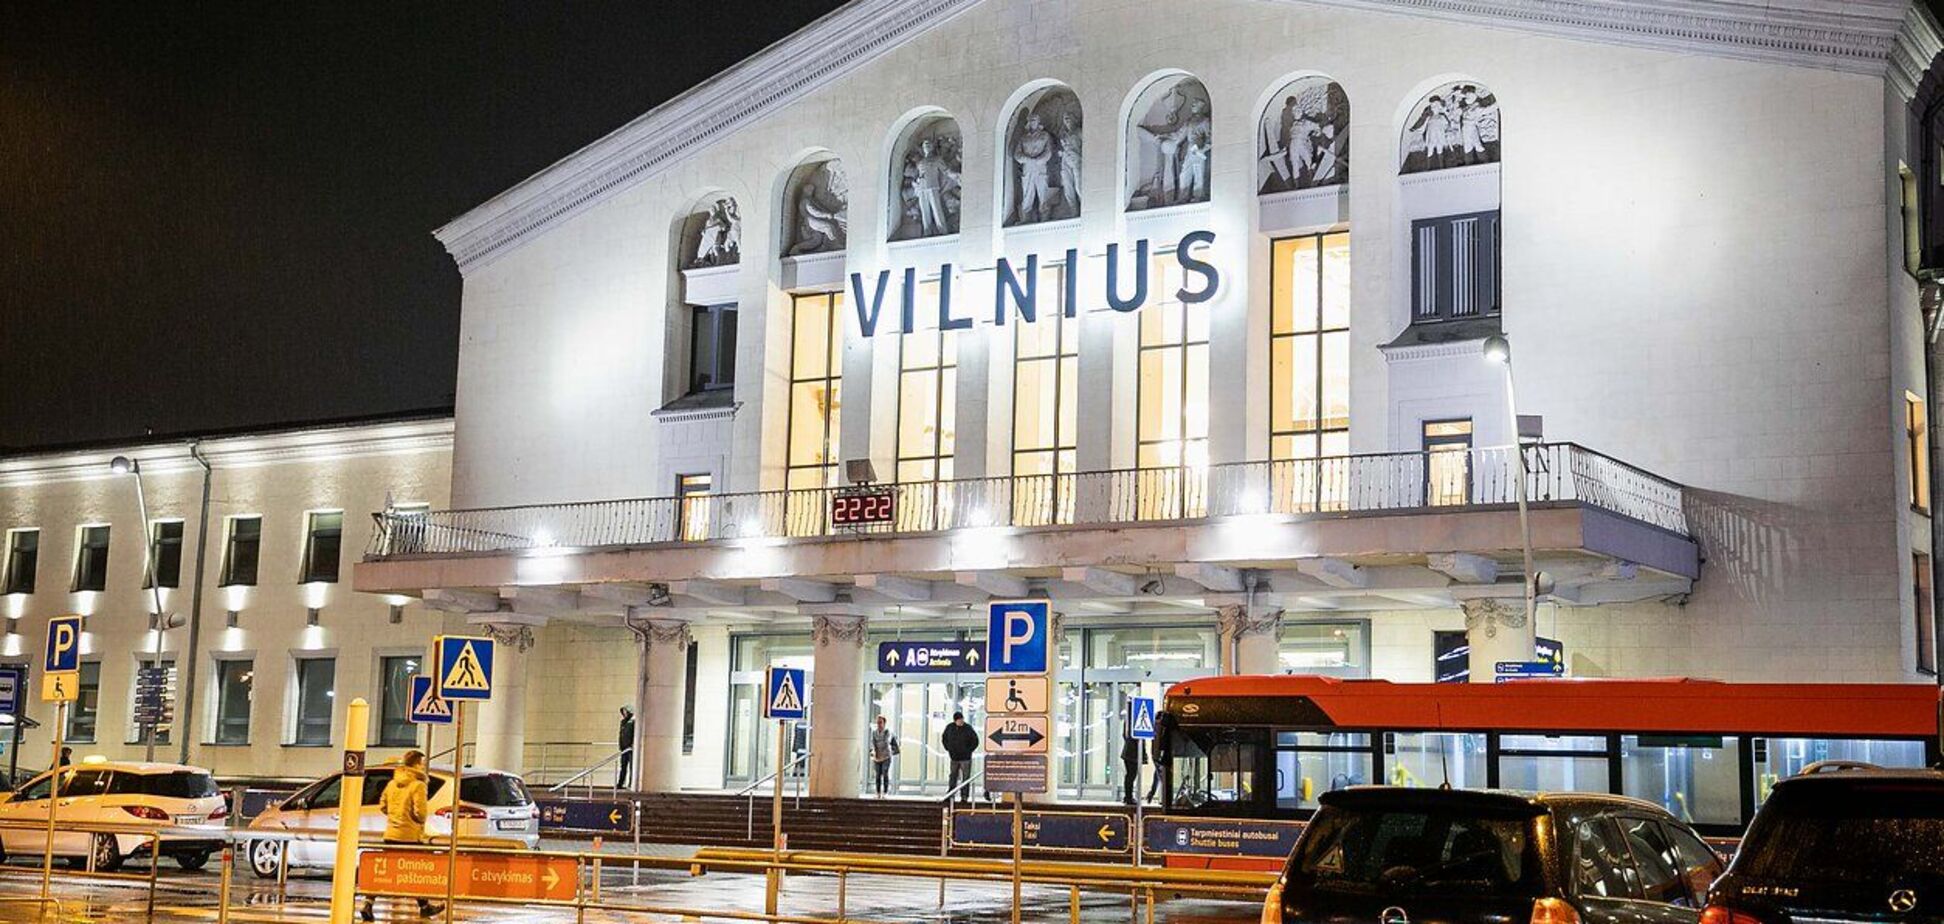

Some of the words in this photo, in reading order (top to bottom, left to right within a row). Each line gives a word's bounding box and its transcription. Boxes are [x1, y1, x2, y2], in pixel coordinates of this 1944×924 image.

[851, 230, 1219, 337] VILNIUS
[53, 623, 74, 667] P
[1003, 611, 1035, 664] P
[1190, 837, 1217, 847] Shuttle
[1218, 839, 1239, 848] buses
[398, 858, 435, 871] Omniva
[481, 868, 533, 886] atvykimas
